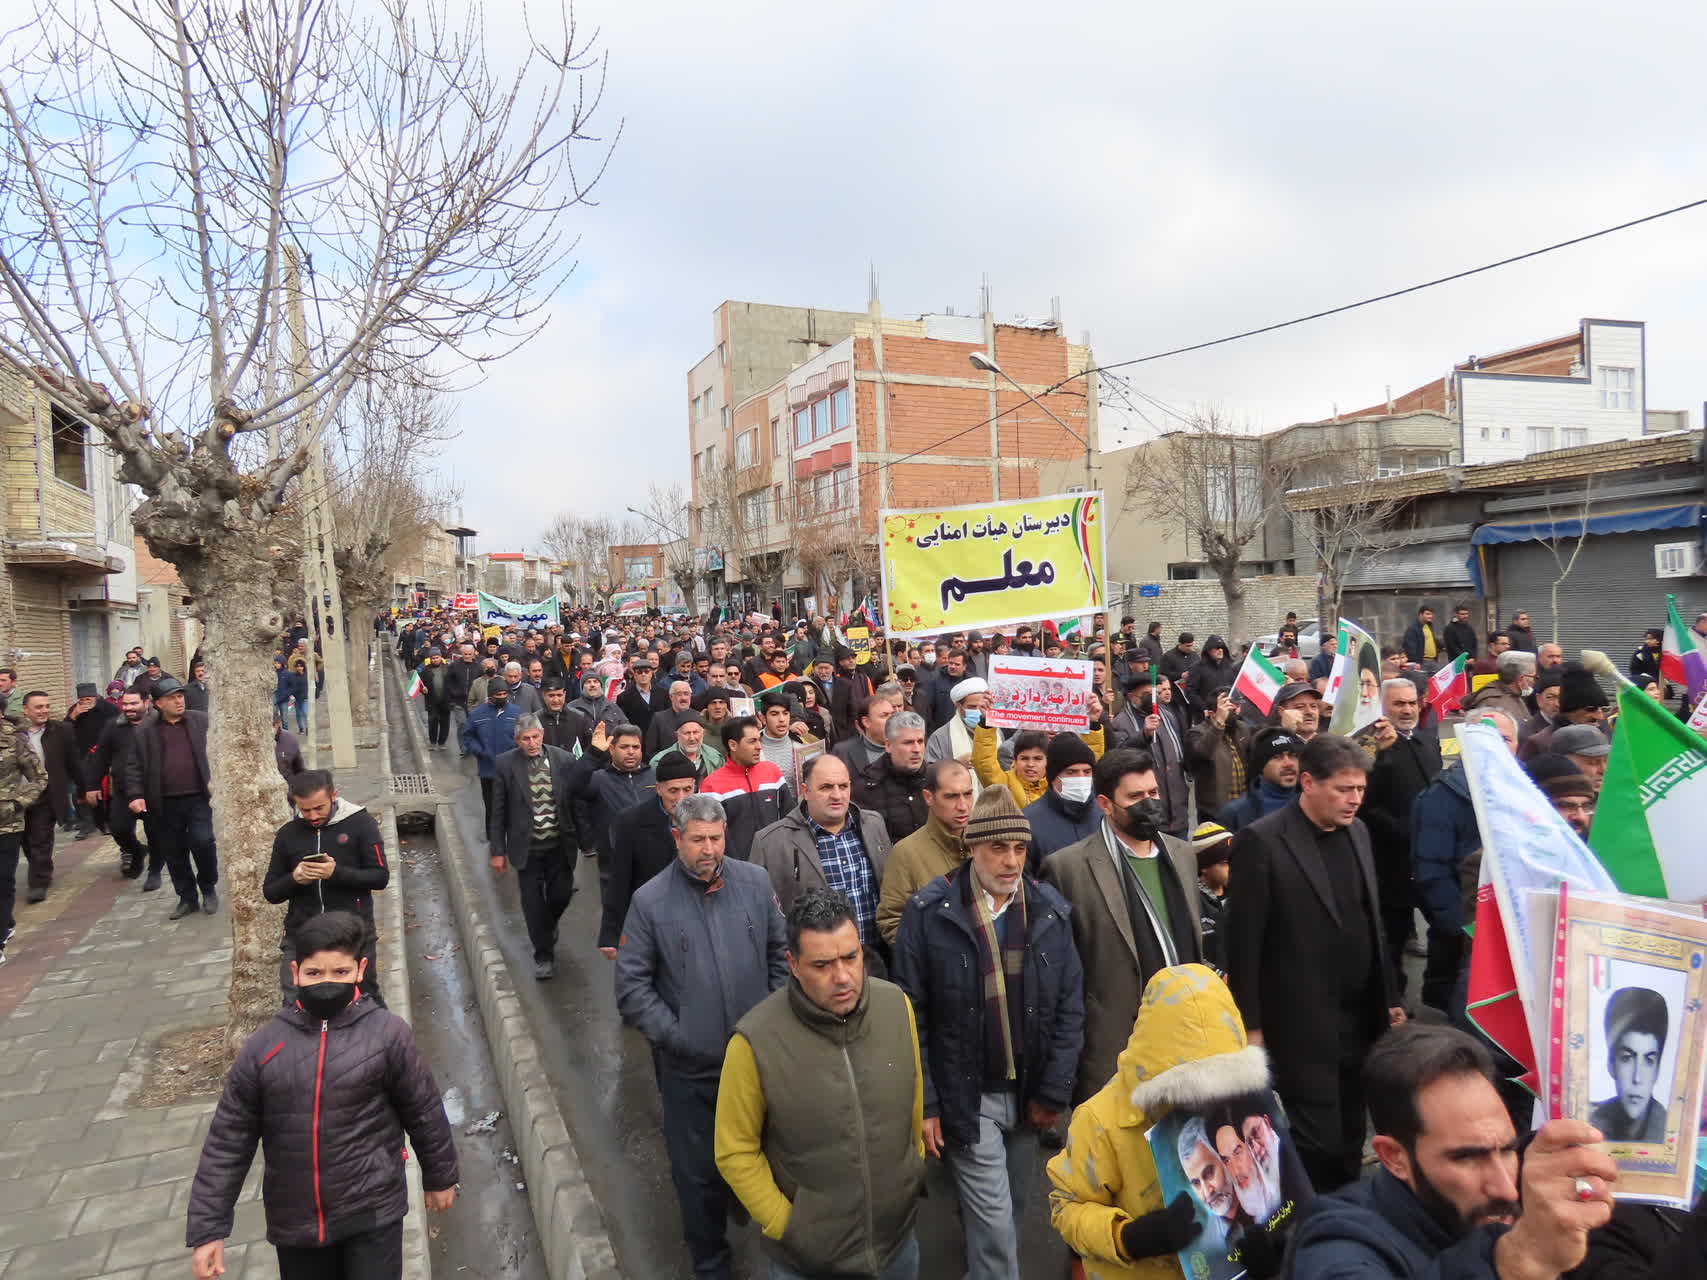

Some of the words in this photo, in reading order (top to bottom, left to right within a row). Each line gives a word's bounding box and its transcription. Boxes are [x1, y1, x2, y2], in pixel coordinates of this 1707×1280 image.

[916, 521, 968, 548] امنایی
[1012, 513, 1070, 539] دبیرستان
[941, 548, 1055, 611] معلم
[517, 612, 548, 624] مهد
[994, 663, 1086, 680] نهضت
[1047, 690, 1086, 705] ادامه
[990, 710, 1005, 719] The
[1006, 712, 1046, 722] movement
[1047, 715, 1084, 724] continues
